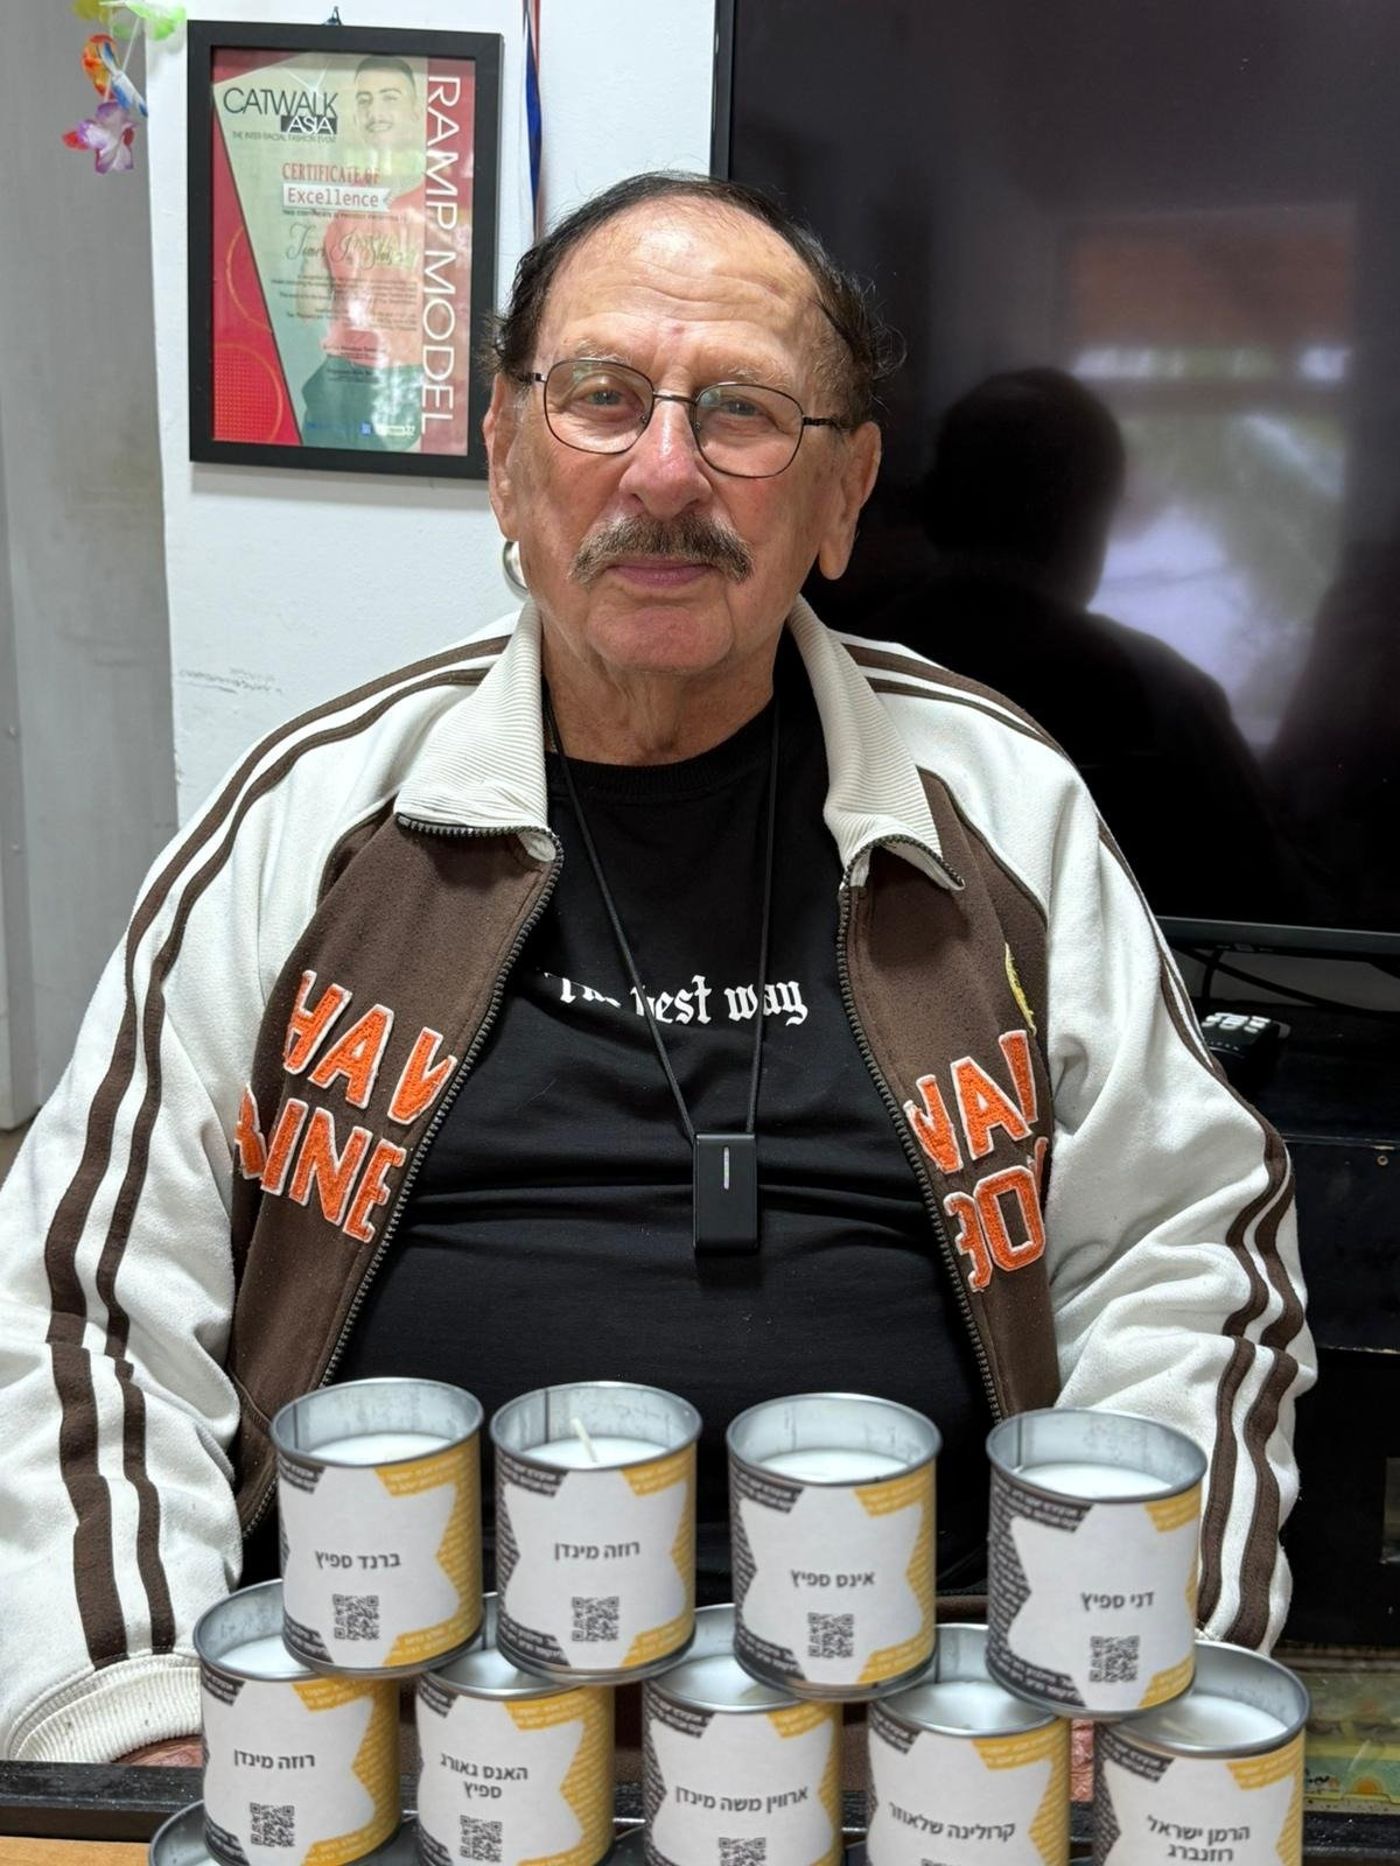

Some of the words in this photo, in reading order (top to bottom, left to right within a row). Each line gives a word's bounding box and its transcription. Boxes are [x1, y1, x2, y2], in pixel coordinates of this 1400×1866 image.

[222, 87, 338, 119] CATWALK
[287, 115, 335, 135] ASIA
[425, 76, 461, 231] RAMP
[282, 163, 361, 184] CERTIFICATE
[287, 187, 379, 208] Excellence
[421, 250, 456, 435] MODEL
[724, 980, 808, 1027] way
[315, 1550, 353, 1570] ספיץ
[603, 1542, 640, 1559] רוזה
[357, 1552, 401, 1570] ברנד
[791, 1569, 831, 1588] ספיץ
[836, 1571, 875, 1588] אינס
[1081, 1592, 1125, 1611] ספיץ
[1129, 1591, 1155, 1607] דני
[277, 1754, 316, 1769] רוזה
[482, 1766, 529, 1781] האנס
[462, 1780, 502, 1799] ספיץ
[719, 1797, 763, 1812] משה
[947, 1822, 1016, 1842] קרולינה
[1147, 1814, 1204, 1841] ישראל
[1207, 1825, 1250, 1846] הרמן
[1167, 1843, 1234, 1863] רוזנברג
